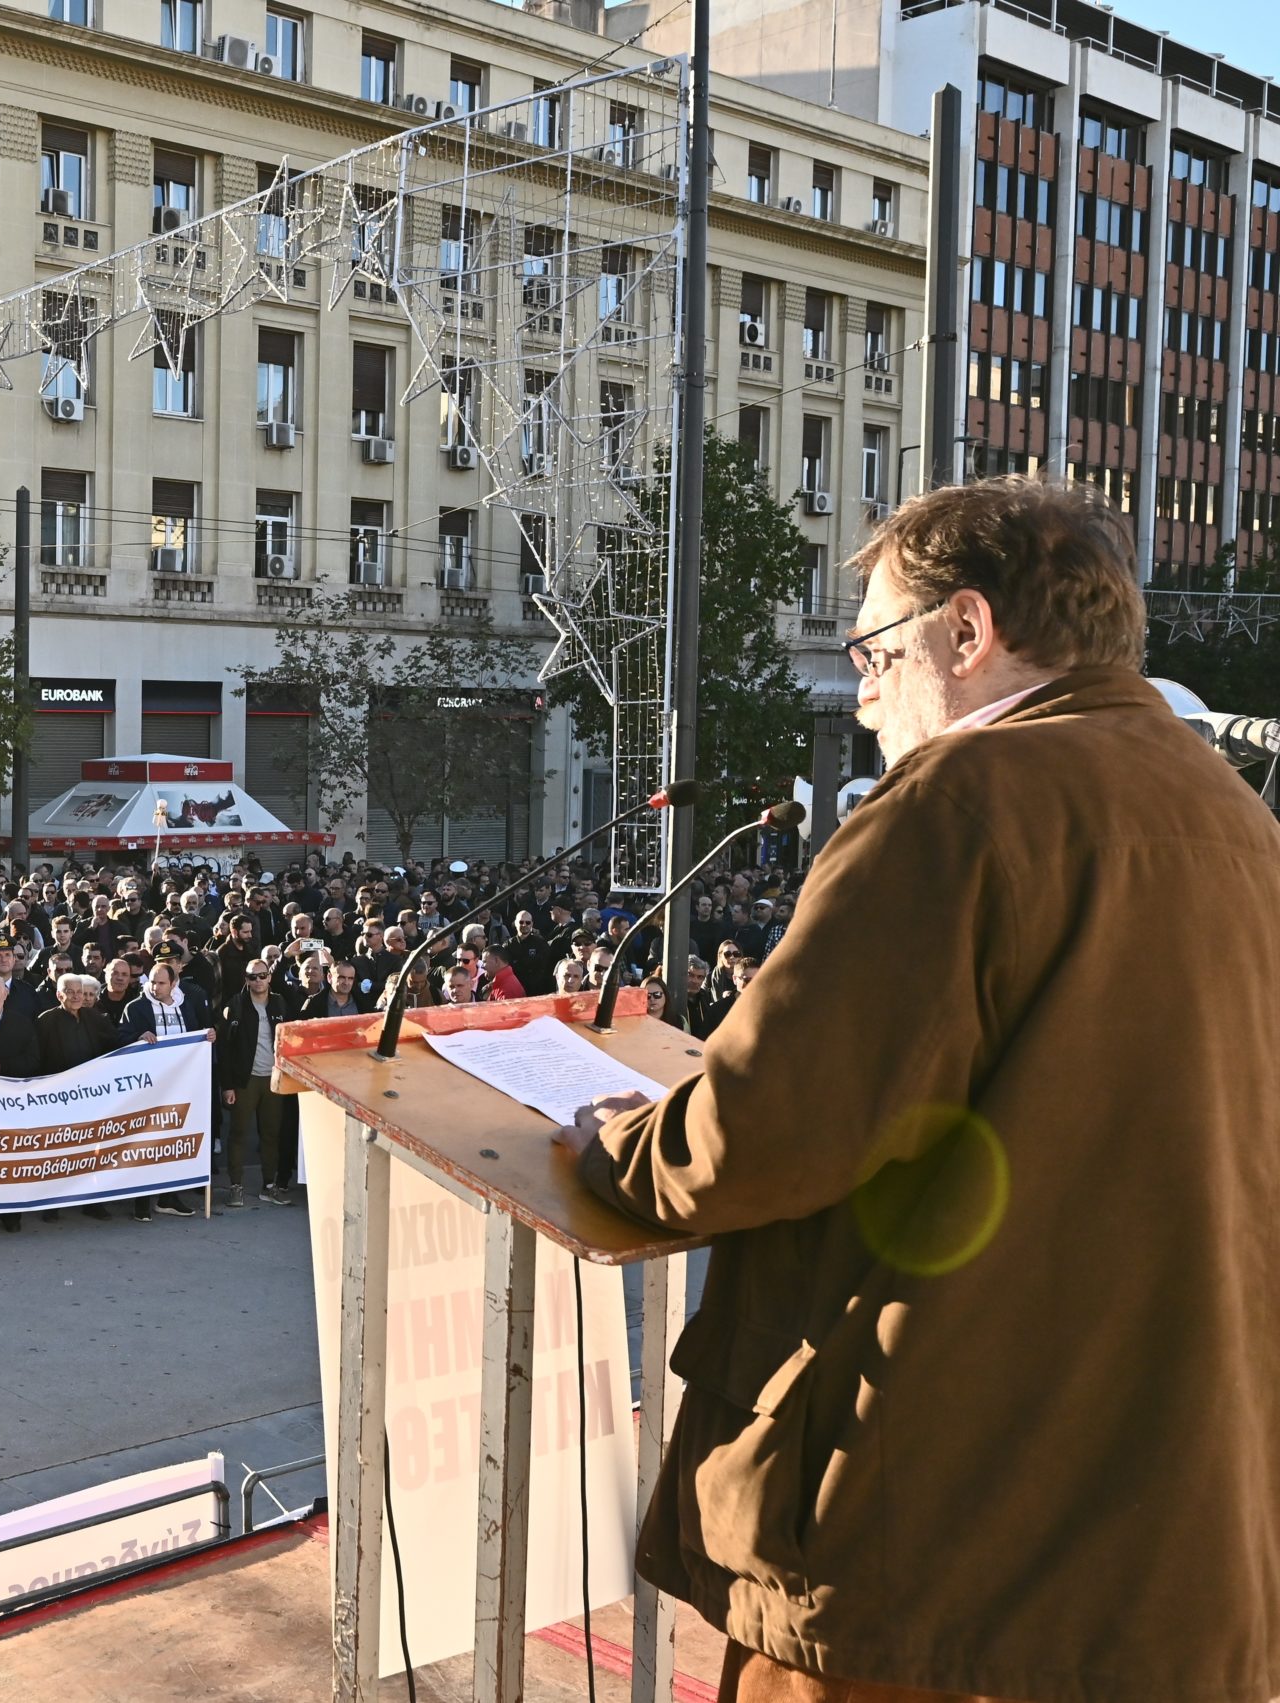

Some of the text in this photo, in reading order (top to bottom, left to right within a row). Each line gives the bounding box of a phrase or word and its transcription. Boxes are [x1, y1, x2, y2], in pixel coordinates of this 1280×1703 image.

[41, 688, 104, 702] EUROBANK
[26, 1082, 111, 1107] Αποφοίτων
[114, 1072, 153, 1092] ΣΤΥΑ
[12, 1133, 39, 1150] μας
[44, 1127, 94, 1148] μάθαμε
[97, 1118, 127, 1139] ήθος
[129, 1116, 147, 1130] και
[149, 1107, 183, 1127] τιμή,
[12, 1154, 96, 1179] υποβάθμιση
[100, 1150, 118, 1167] ως
[121, 1137, 197, 1162] ανταμοιβή!
